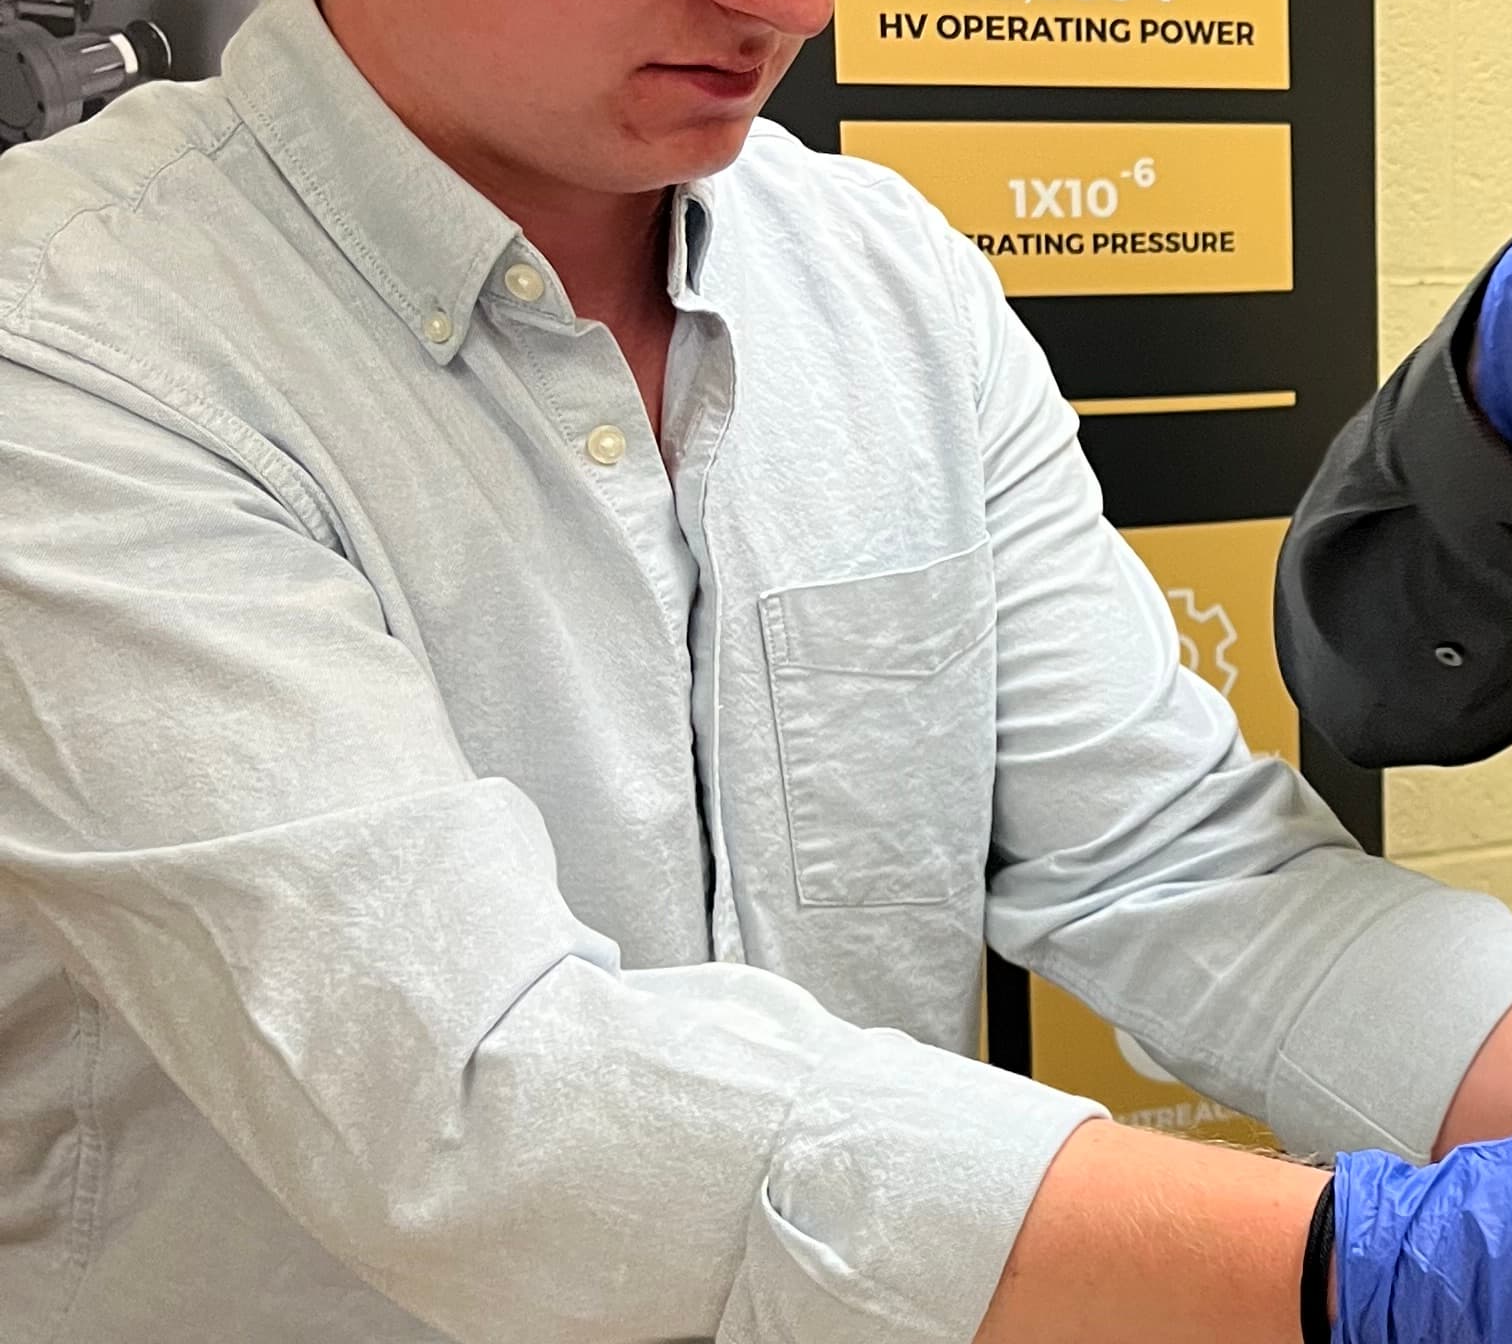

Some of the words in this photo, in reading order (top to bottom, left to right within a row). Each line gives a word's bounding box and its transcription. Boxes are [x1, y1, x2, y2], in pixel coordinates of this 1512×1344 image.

[879, 13, 929, 40] HV
[936, 14, 1132, 44] OPERATING
[1140, 20, 1255, 46] POWER
[1093, 231, 1236, 255] PRESSURE
